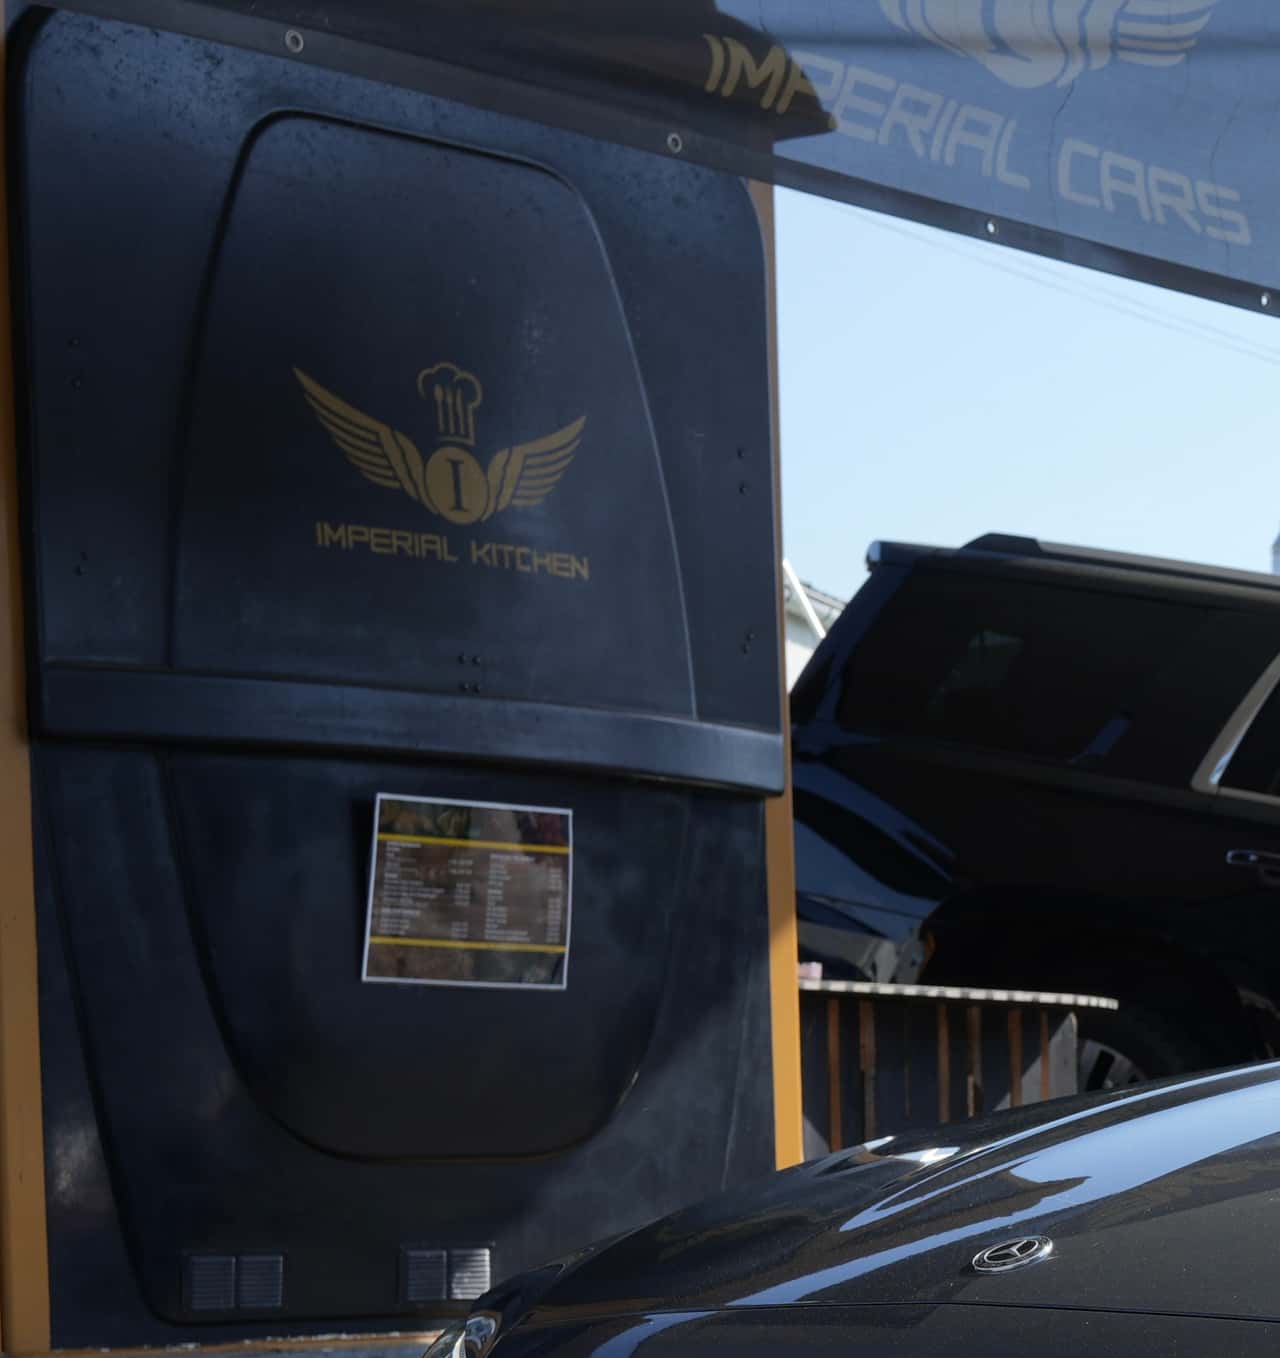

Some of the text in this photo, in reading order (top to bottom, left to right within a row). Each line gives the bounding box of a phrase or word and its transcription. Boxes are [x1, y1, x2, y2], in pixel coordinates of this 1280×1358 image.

[703, 33, 1252, 246] IMPERIAL CARS
[315, 522, 590, 581] IMPERIAL KITCHEN
